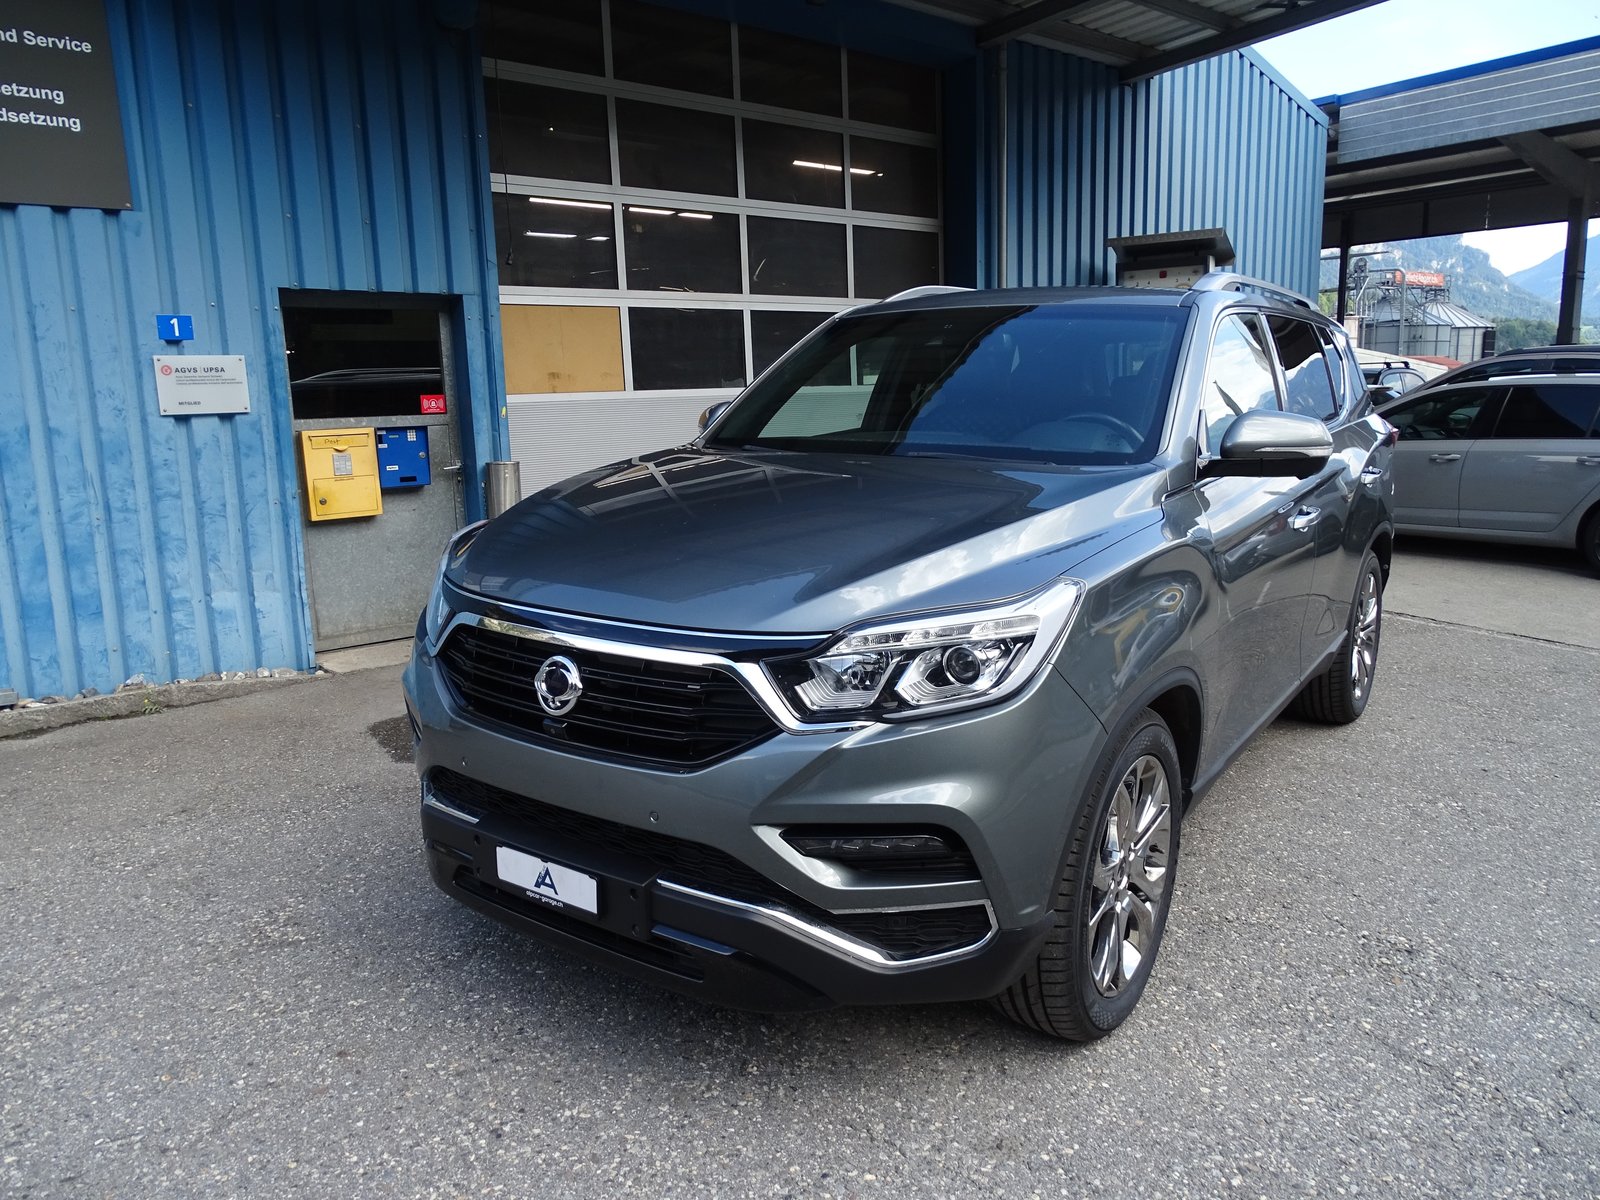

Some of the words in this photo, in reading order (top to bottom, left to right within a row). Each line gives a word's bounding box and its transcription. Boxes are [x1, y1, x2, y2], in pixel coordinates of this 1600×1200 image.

[23, 30, 92, 53] Service
[0, 83, 65, 105] etzung
[169, 317, 180, 337] 1
[174, 366, 198, 374] AGVS
[203, 366, 226, 374] UPSA
